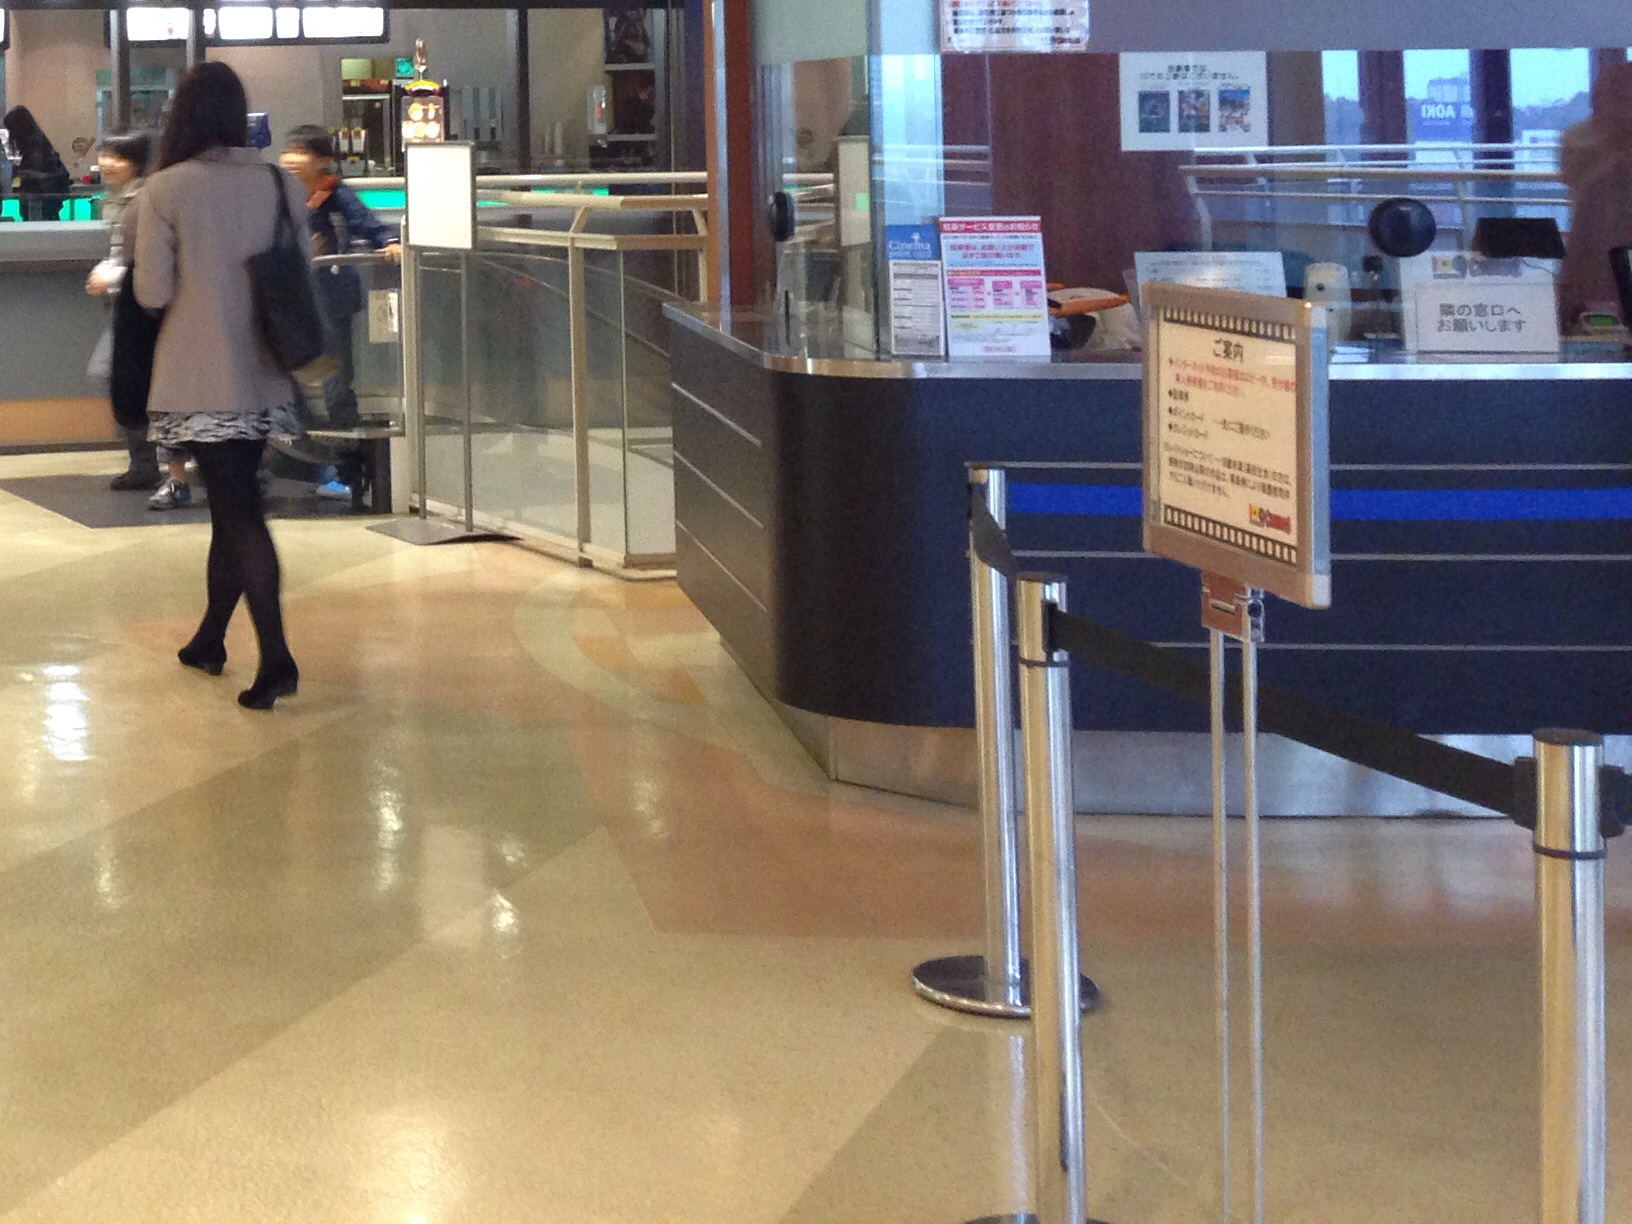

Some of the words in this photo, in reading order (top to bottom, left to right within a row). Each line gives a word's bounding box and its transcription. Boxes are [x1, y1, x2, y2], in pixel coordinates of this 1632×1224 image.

[1437, 318, 1526, 333] お願いします
[1213, 338, 1244, 363] ご案内
